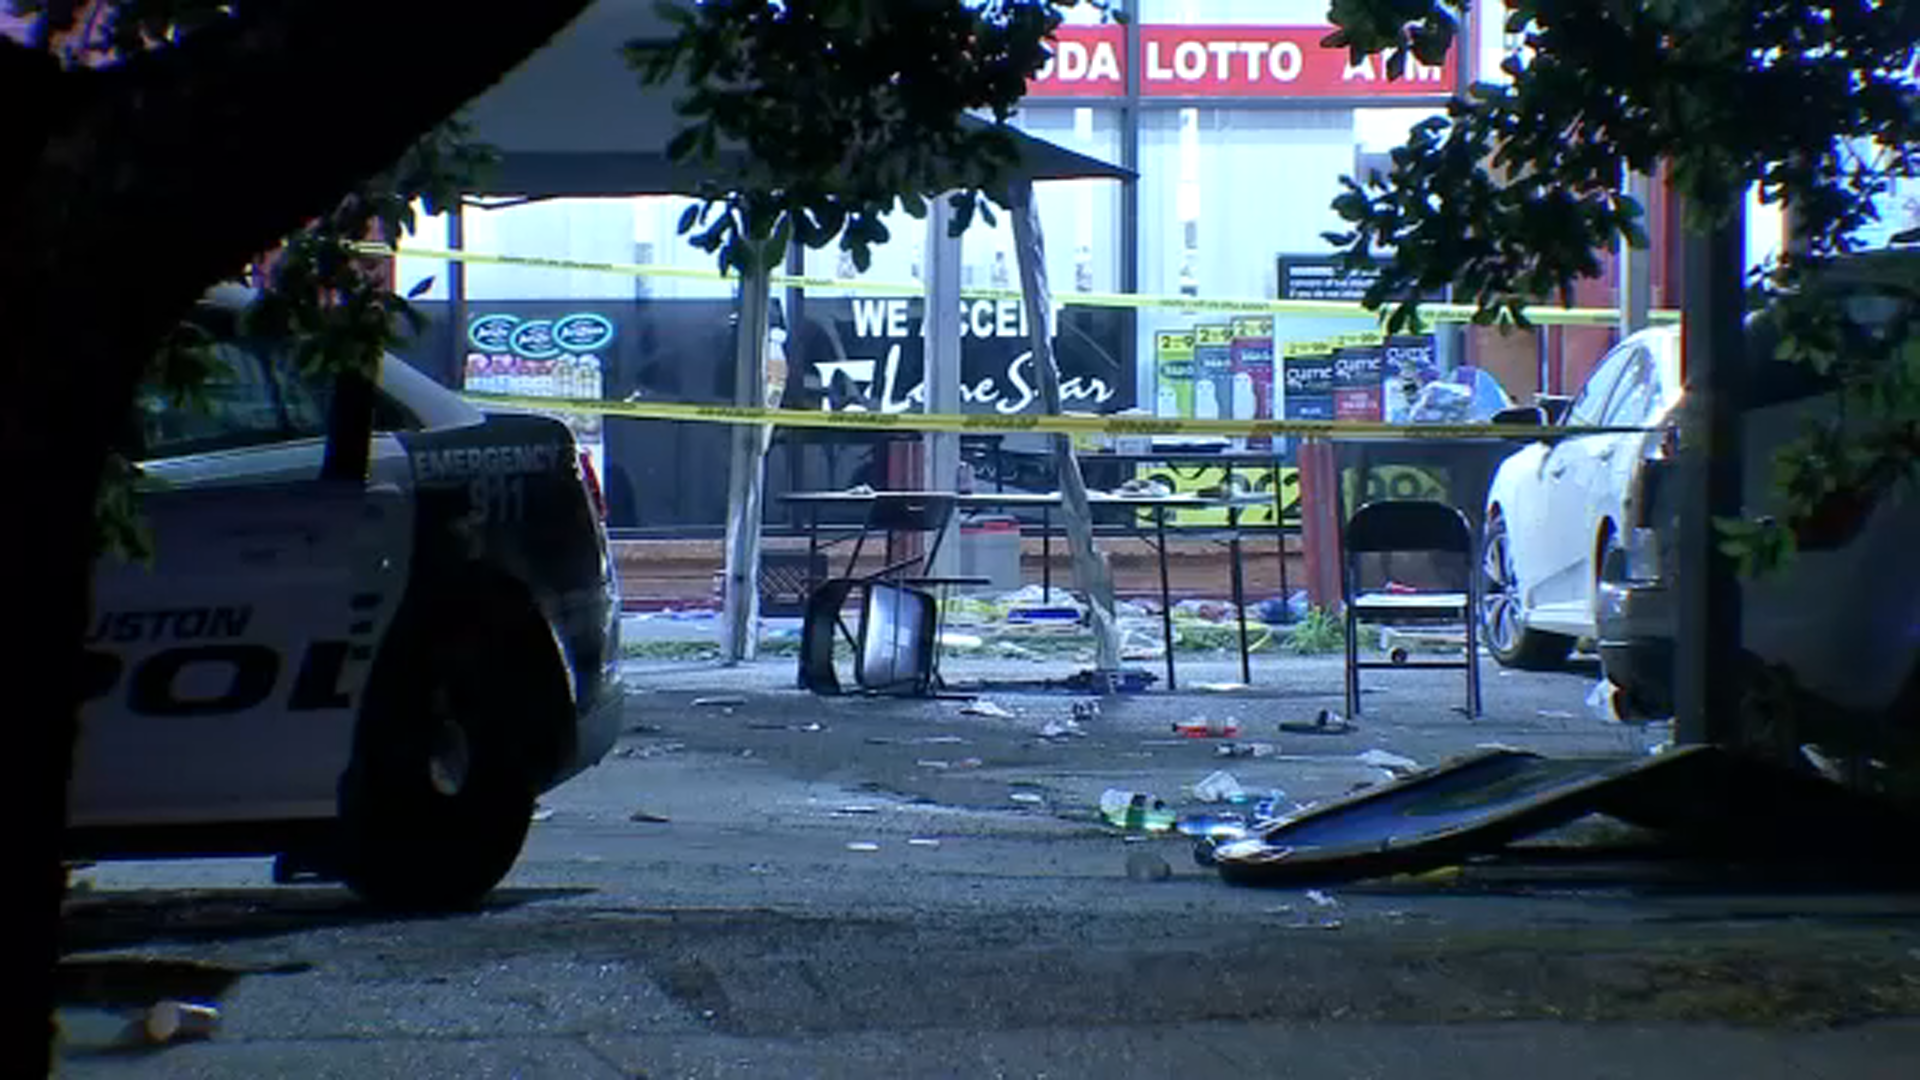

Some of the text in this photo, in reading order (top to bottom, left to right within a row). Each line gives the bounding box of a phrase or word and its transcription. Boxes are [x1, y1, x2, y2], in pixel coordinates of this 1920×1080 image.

[1146, 41, 1303, 81] LOTTO
[852, 299, 1065, 337] WE CET
[996, 351, 1114, 413] Sar
[413, 443, 560, 481] EMERGENCY
[468, 474, 526, 525] 911
